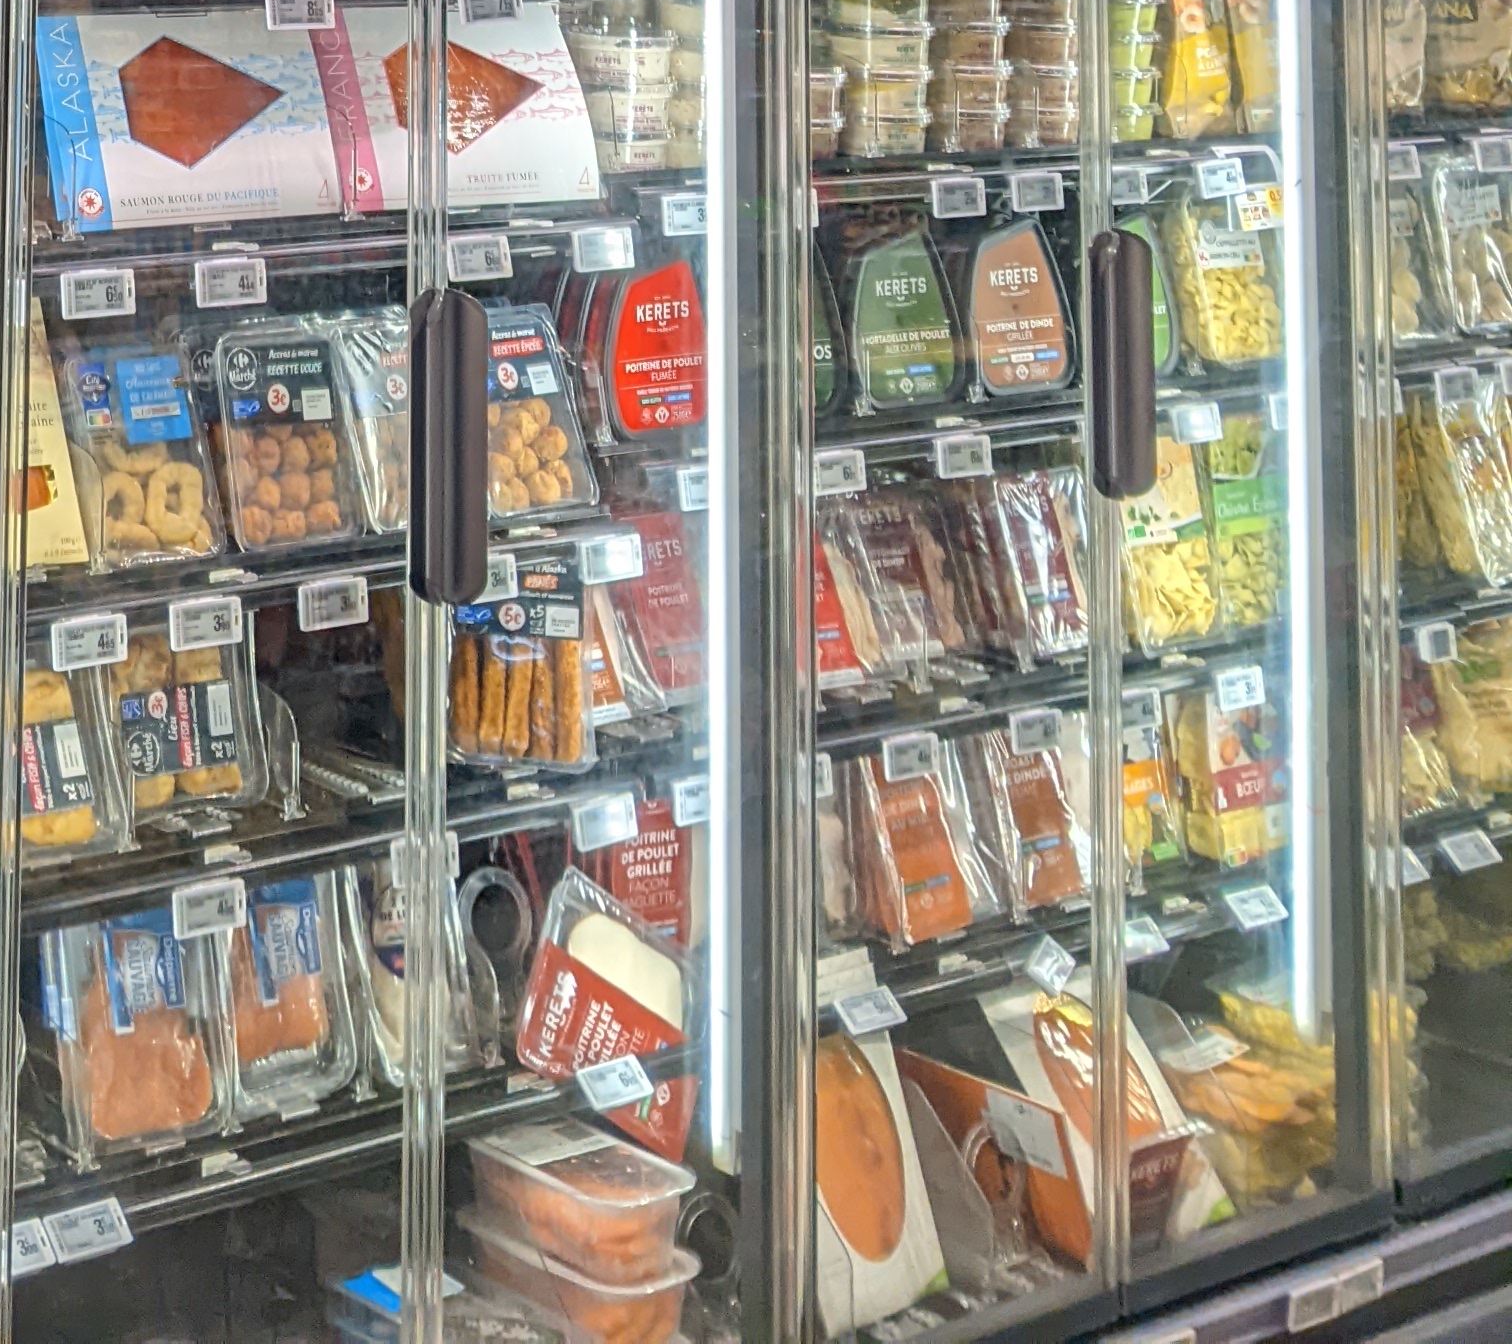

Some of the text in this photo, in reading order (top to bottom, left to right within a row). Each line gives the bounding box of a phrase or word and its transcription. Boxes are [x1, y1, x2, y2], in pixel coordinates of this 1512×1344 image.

[49, 22, 94, 163] ALASKA
[467, 172, 540, 185] TRUITE FUMÉE
[120, 187, 280, 208] SAUMON ROUGE DU PACIFIQUE
[989, 266, 1039, 286] KERETS
[875, 277, 928, 297] KERETS
[636, 300, 690, 323] KERETS
[920, 328, 950, 342] POULET
[986, 317, 1054, 334] POITRINE DE DINDE
[267, 362, 322, 376] RECETTE DOUCE
[625, 355, 703, 374] POITRINE DE POULET
[229, 367, 258, 382] Marché
[651, 370, 677, 381] FUMÉE
[168, 715, 178, 741] Lieu
[210, 741, 224, 759] x2
[62, 783, 78, 802] x2
[621, 842, 680, 865] DE POULET
[626, 859, 673, 880] GRILLÉE
[628, 877, 669, 894] FAÇON
